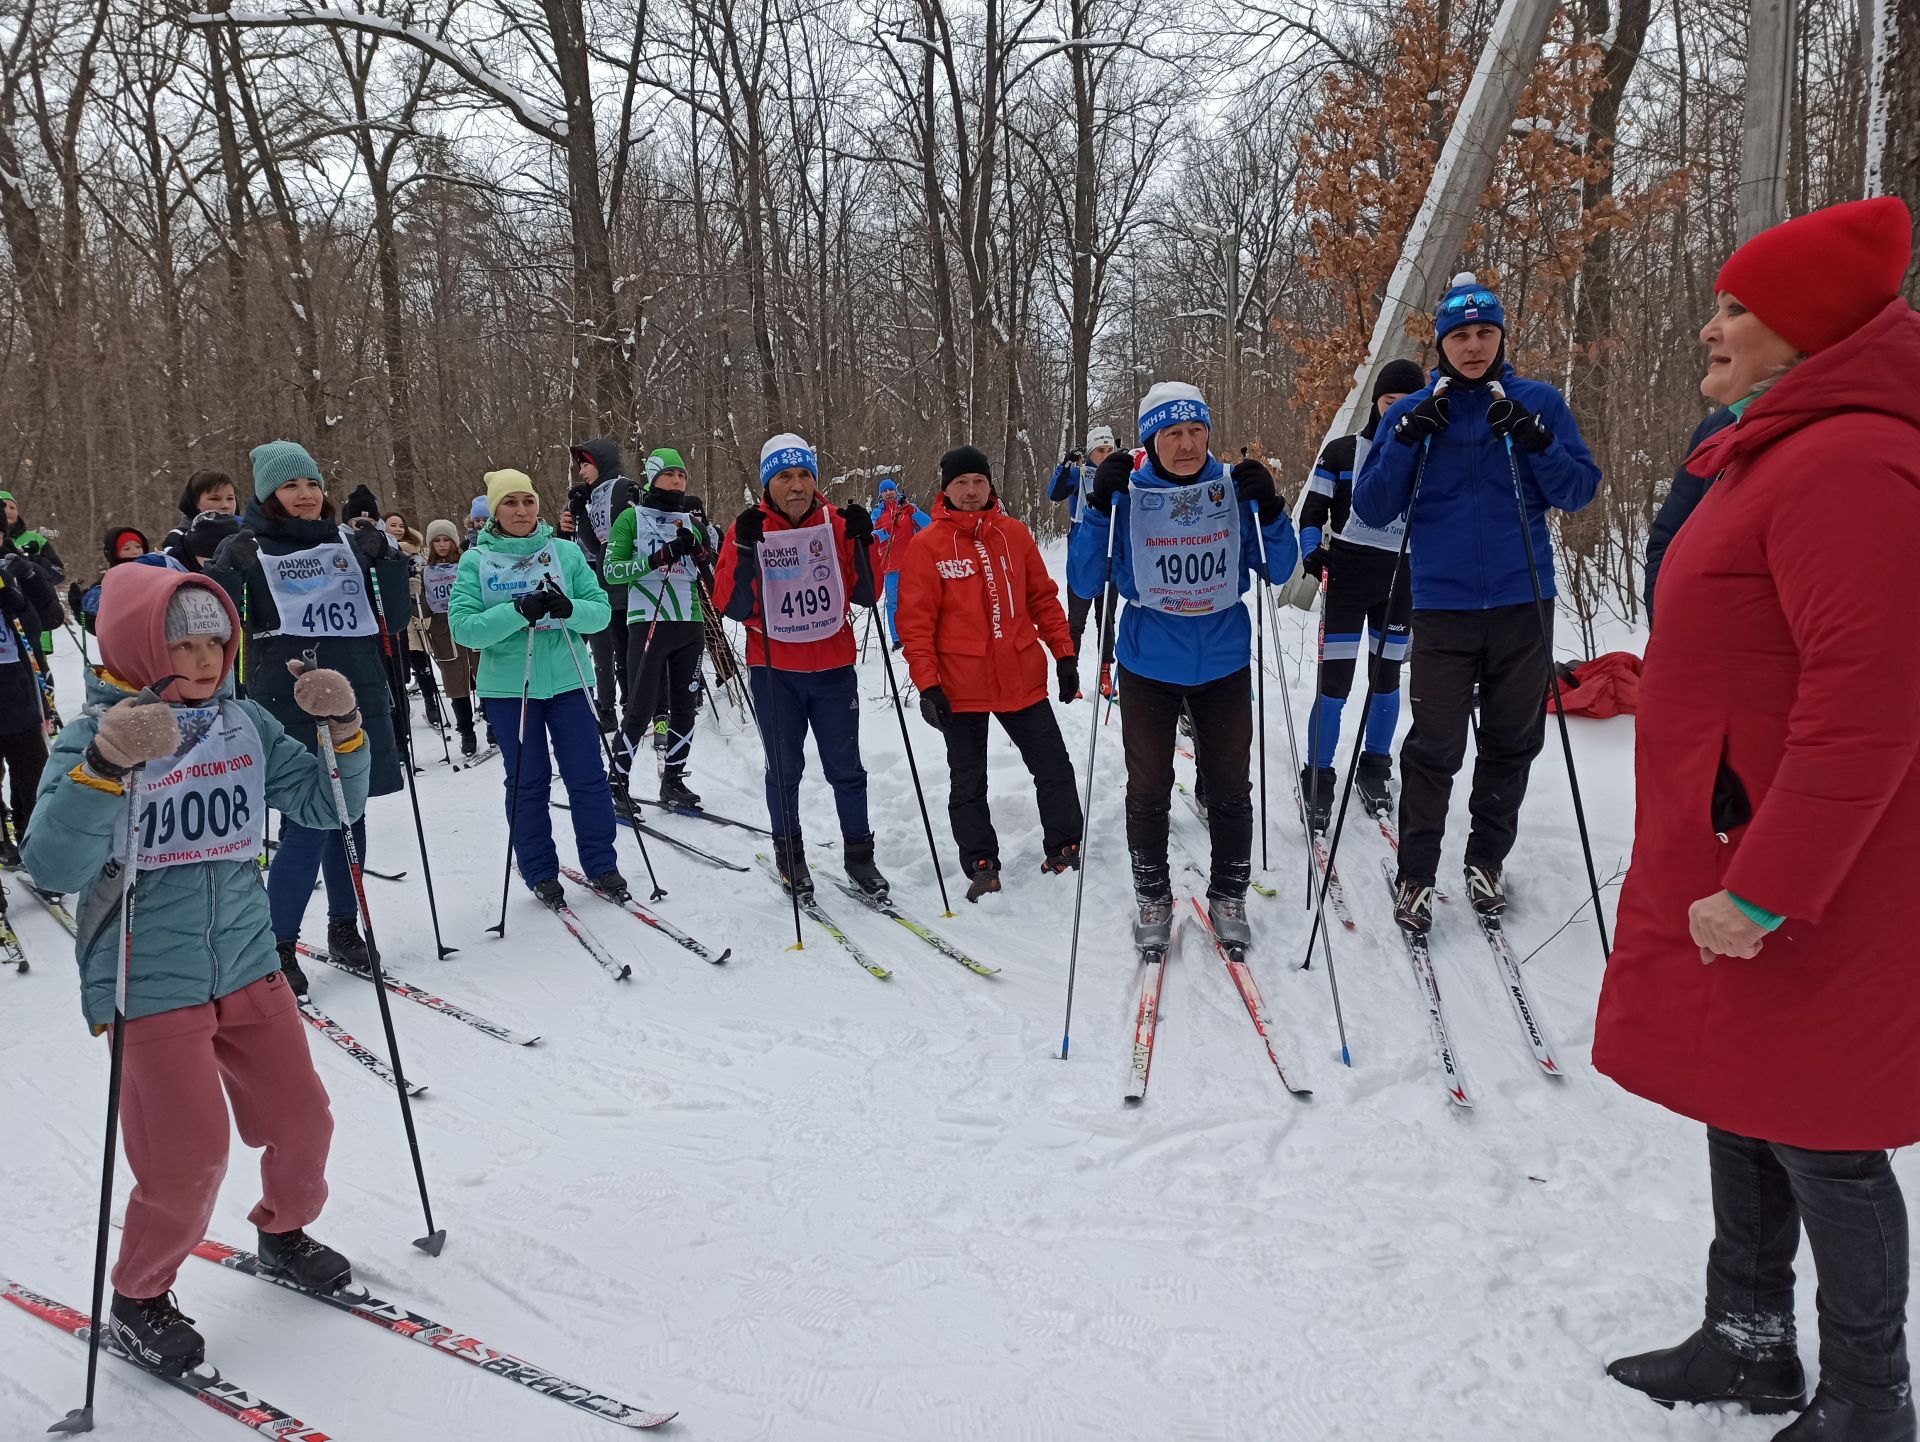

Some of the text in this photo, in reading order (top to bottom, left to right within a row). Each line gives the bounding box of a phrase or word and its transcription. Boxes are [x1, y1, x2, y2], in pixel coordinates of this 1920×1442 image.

[1140, 410, 1167, 433] ЖНЯ
[1145, 537, 1178, 547] ЛЫЖНЯ
[1180, 534, 1212, 546] РОССИИ
[276, 558, 322, 571] ЛЫЖНЯ
[278, 566, 326, 581] РОССИИ
[764, 556, 800, 568] РОССИИ
[1155, 547, 1227, 585] 19004
[1148, 581, 1228, 596] РЕСПУБЛИКА ТАТАРСТАН
[193, 603, 214, 613] CAT
[780, 585, 831, 619] 4199
[193, 620, 221, 630] MEOW
[301, 601, 358, 633] 4163
[773, 623, 810, 634] Республика
[184, 760, 227, 780] РОССИИ
[227, 753, 254, 772] 2010
[138, 784, 251, 849] 19008
[136, 836, 253, 865] СПУБЛИКА ТАТАРСТАН
[1511, 985, 1543, 1048] MADSHUS
[110, 1311, 163, 1365] SPINE
